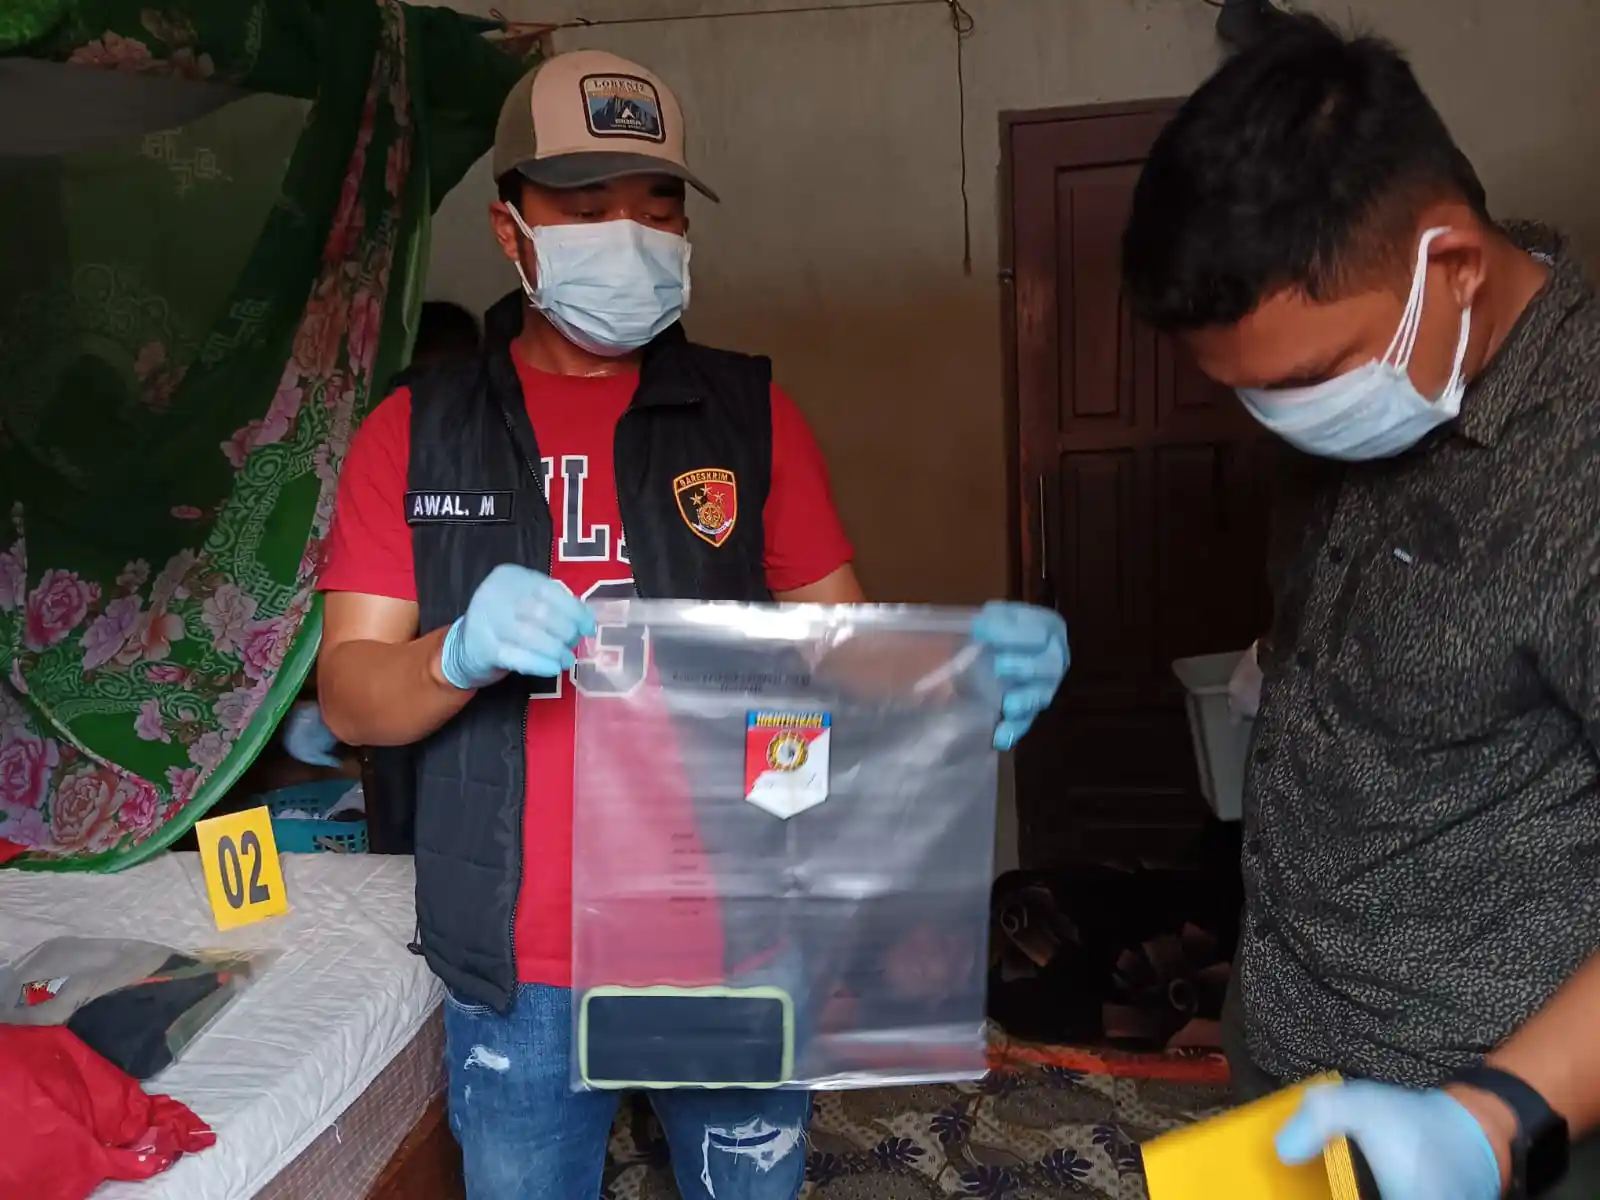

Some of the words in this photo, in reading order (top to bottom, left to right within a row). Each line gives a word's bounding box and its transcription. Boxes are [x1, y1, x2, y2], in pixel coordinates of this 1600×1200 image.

[680, 471, 728, 487] BARESKRIM
[413, 495, 470, 516] AWAL.
[479, 495, 495, 516] M
[218, 830, 270, 909] 02
